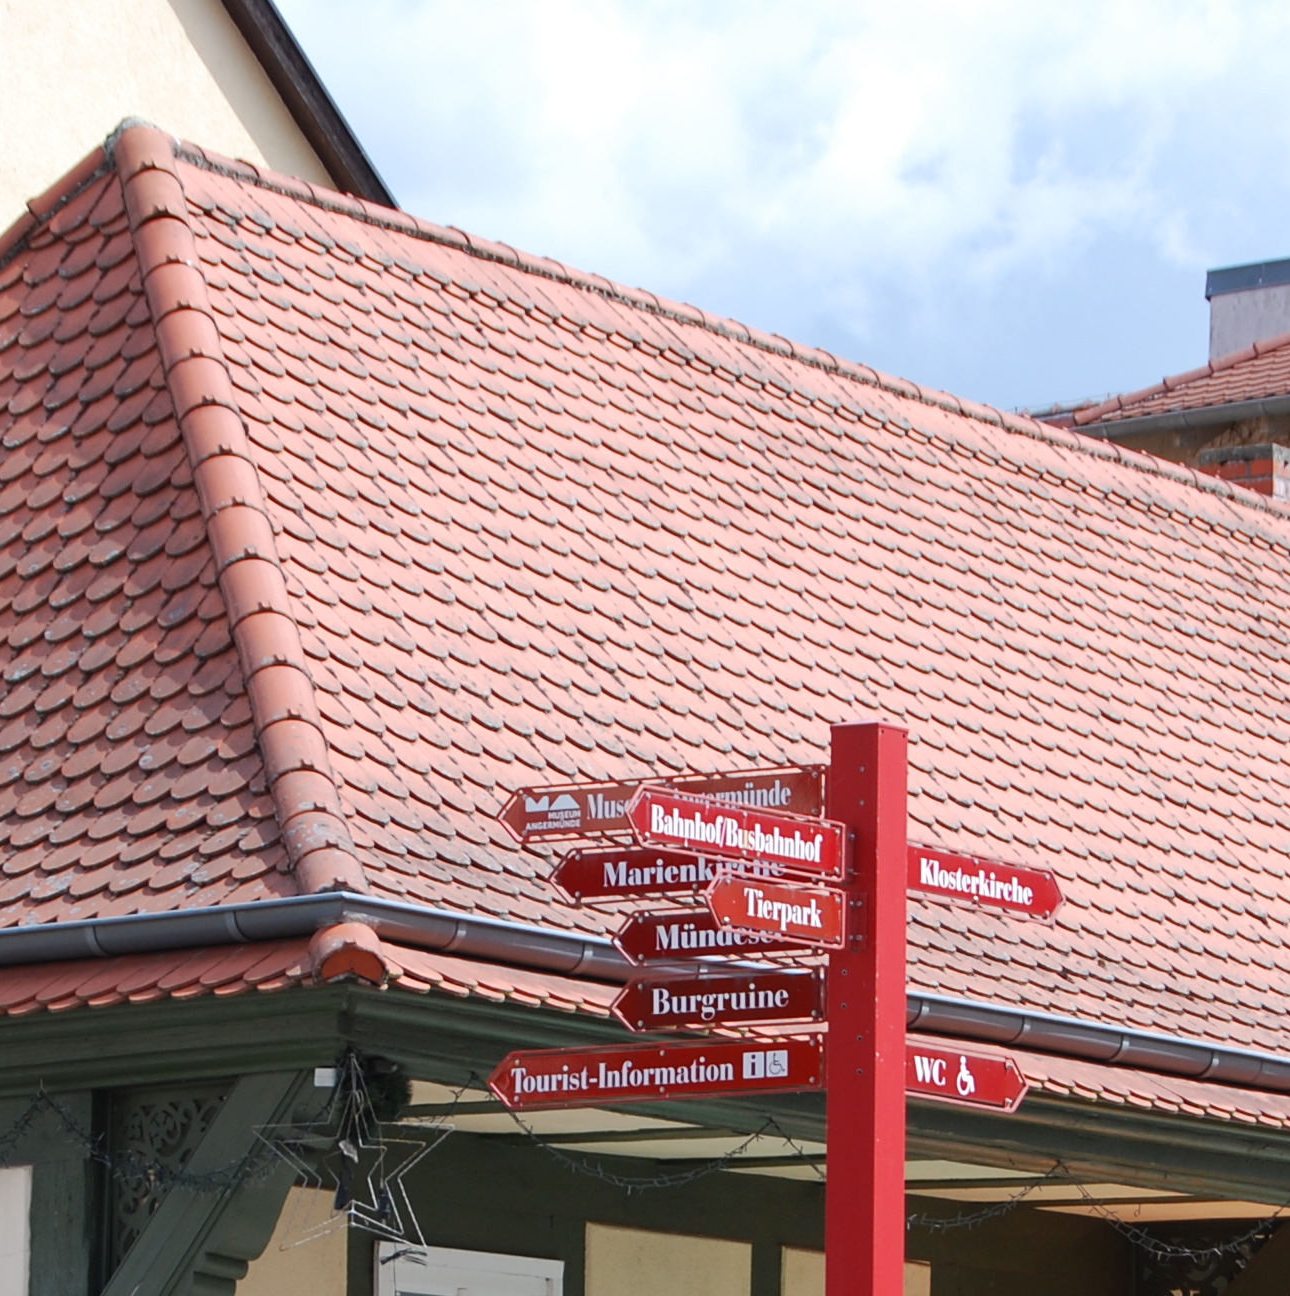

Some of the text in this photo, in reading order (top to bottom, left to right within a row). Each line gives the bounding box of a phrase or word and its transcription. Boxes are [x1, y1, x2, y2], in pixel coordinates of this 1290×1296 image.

[526, 819, 581, 830] ANGERMÜNDE
[548, 810, 581, 820] MUSEUM
[651, 804, 823, 863] Bahnhof/Busbahnhof
[920, 858, 1033, 906] Klosterkirche
[744, 887, 823, 931] Tierpark
[652, 983, 789, 1021] Burgruine
[511, 1056, 734, 1094] Tourist-Information
[914, 1055, 946, 1086] WC
